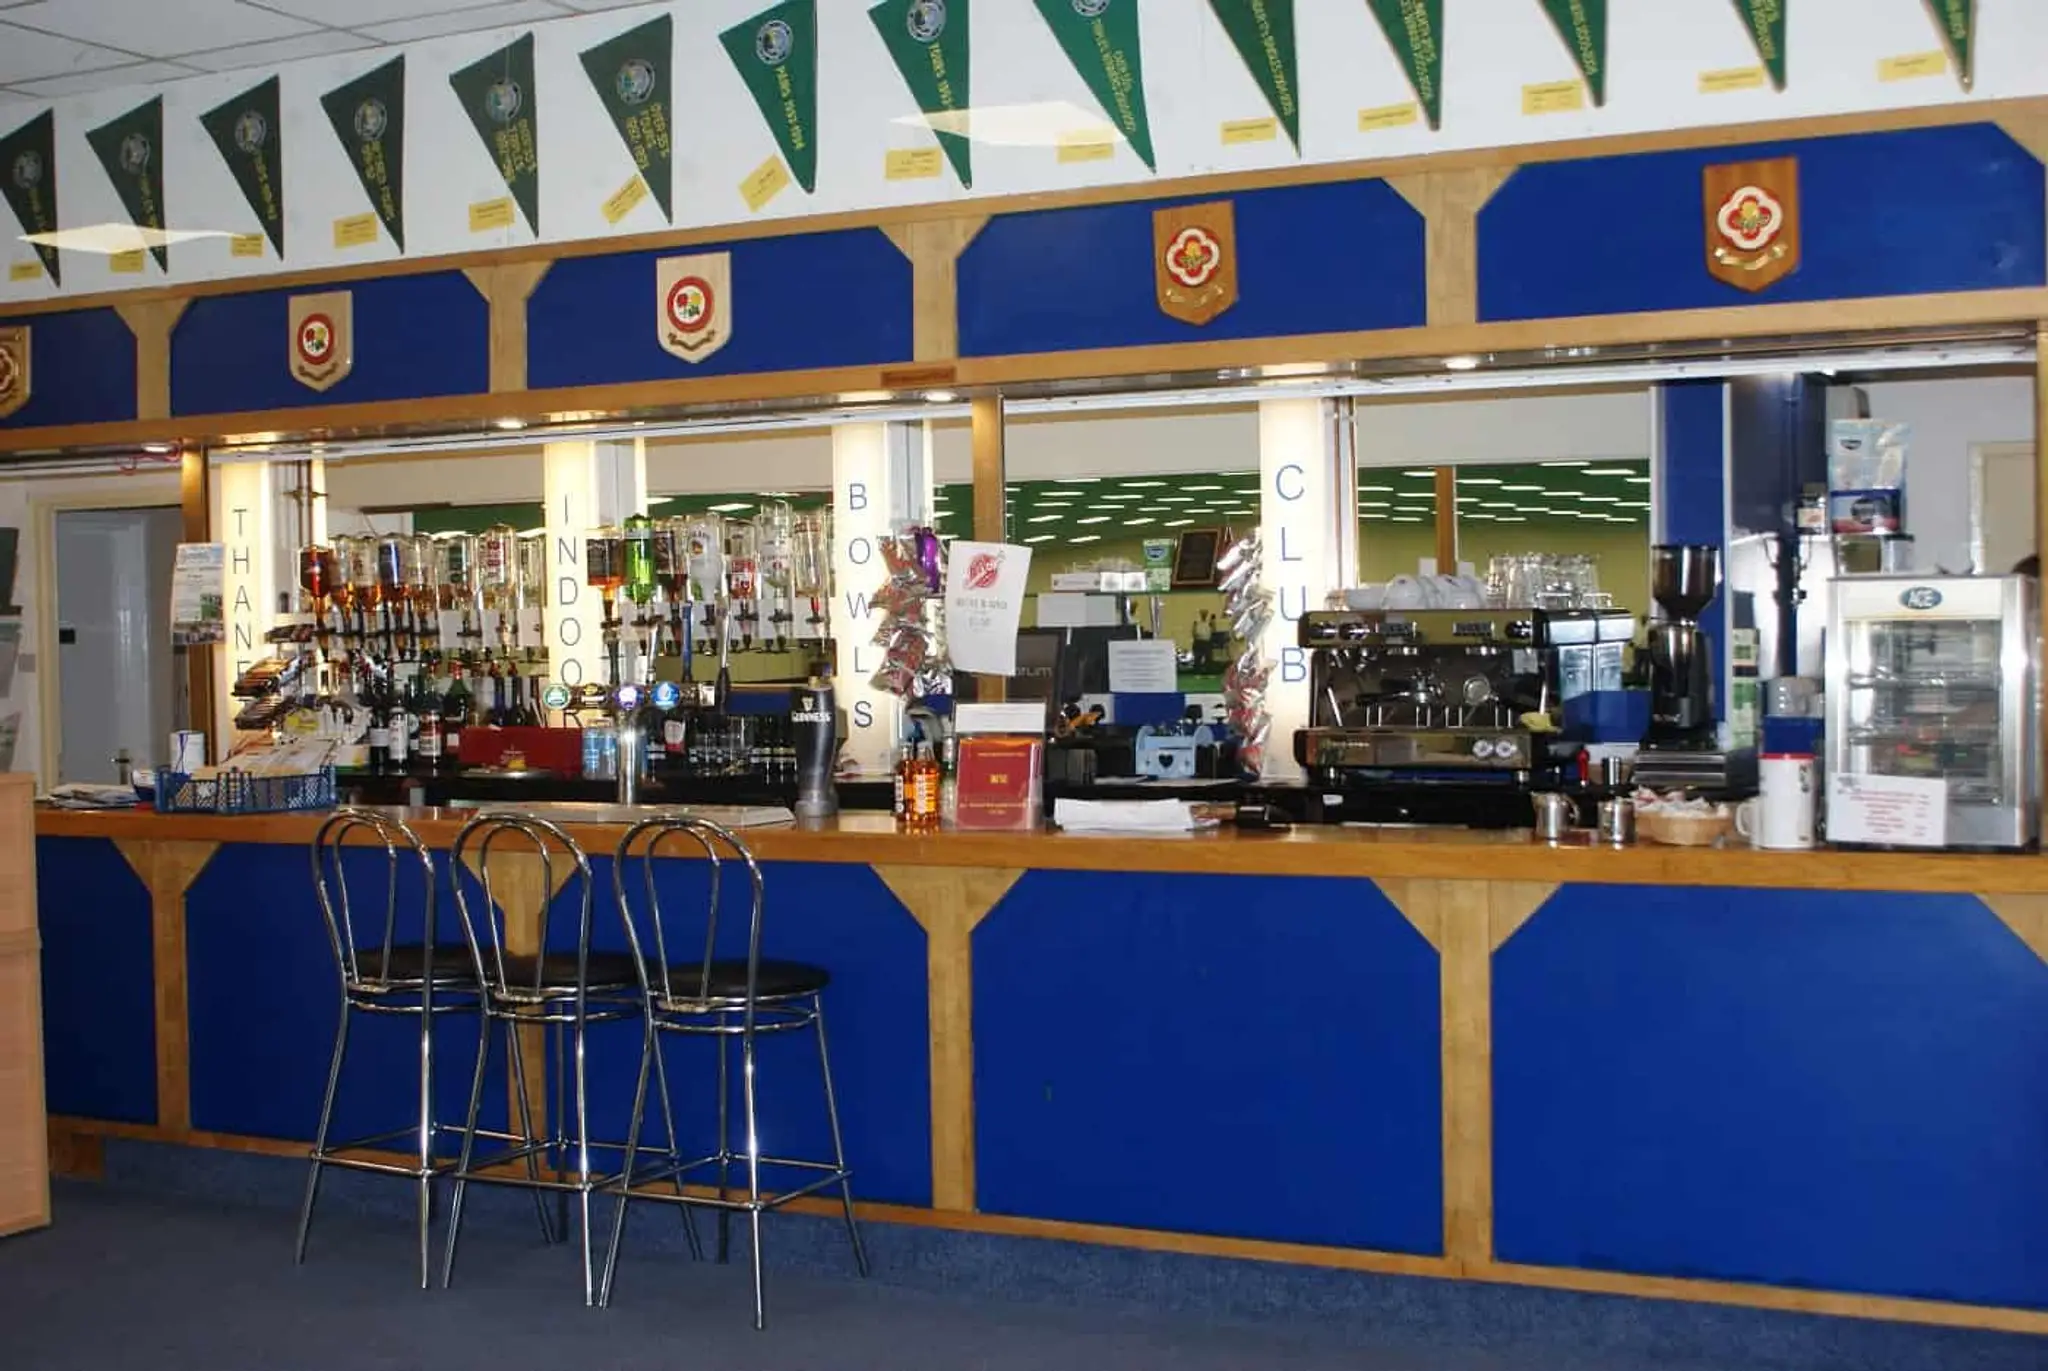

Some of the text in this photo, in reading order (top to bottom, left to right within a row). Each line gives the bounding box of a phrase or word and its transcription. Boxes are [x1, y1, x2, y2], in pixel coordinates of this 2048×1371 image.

[232, 508, 253, 703] THANE
[558, 493, 583, 728] INDOOR
[846, 483, 872, 728] BOWLS
[1276, 464, 1307, 682] CLUB
[791, 711, 831, 723] GUINNESS
